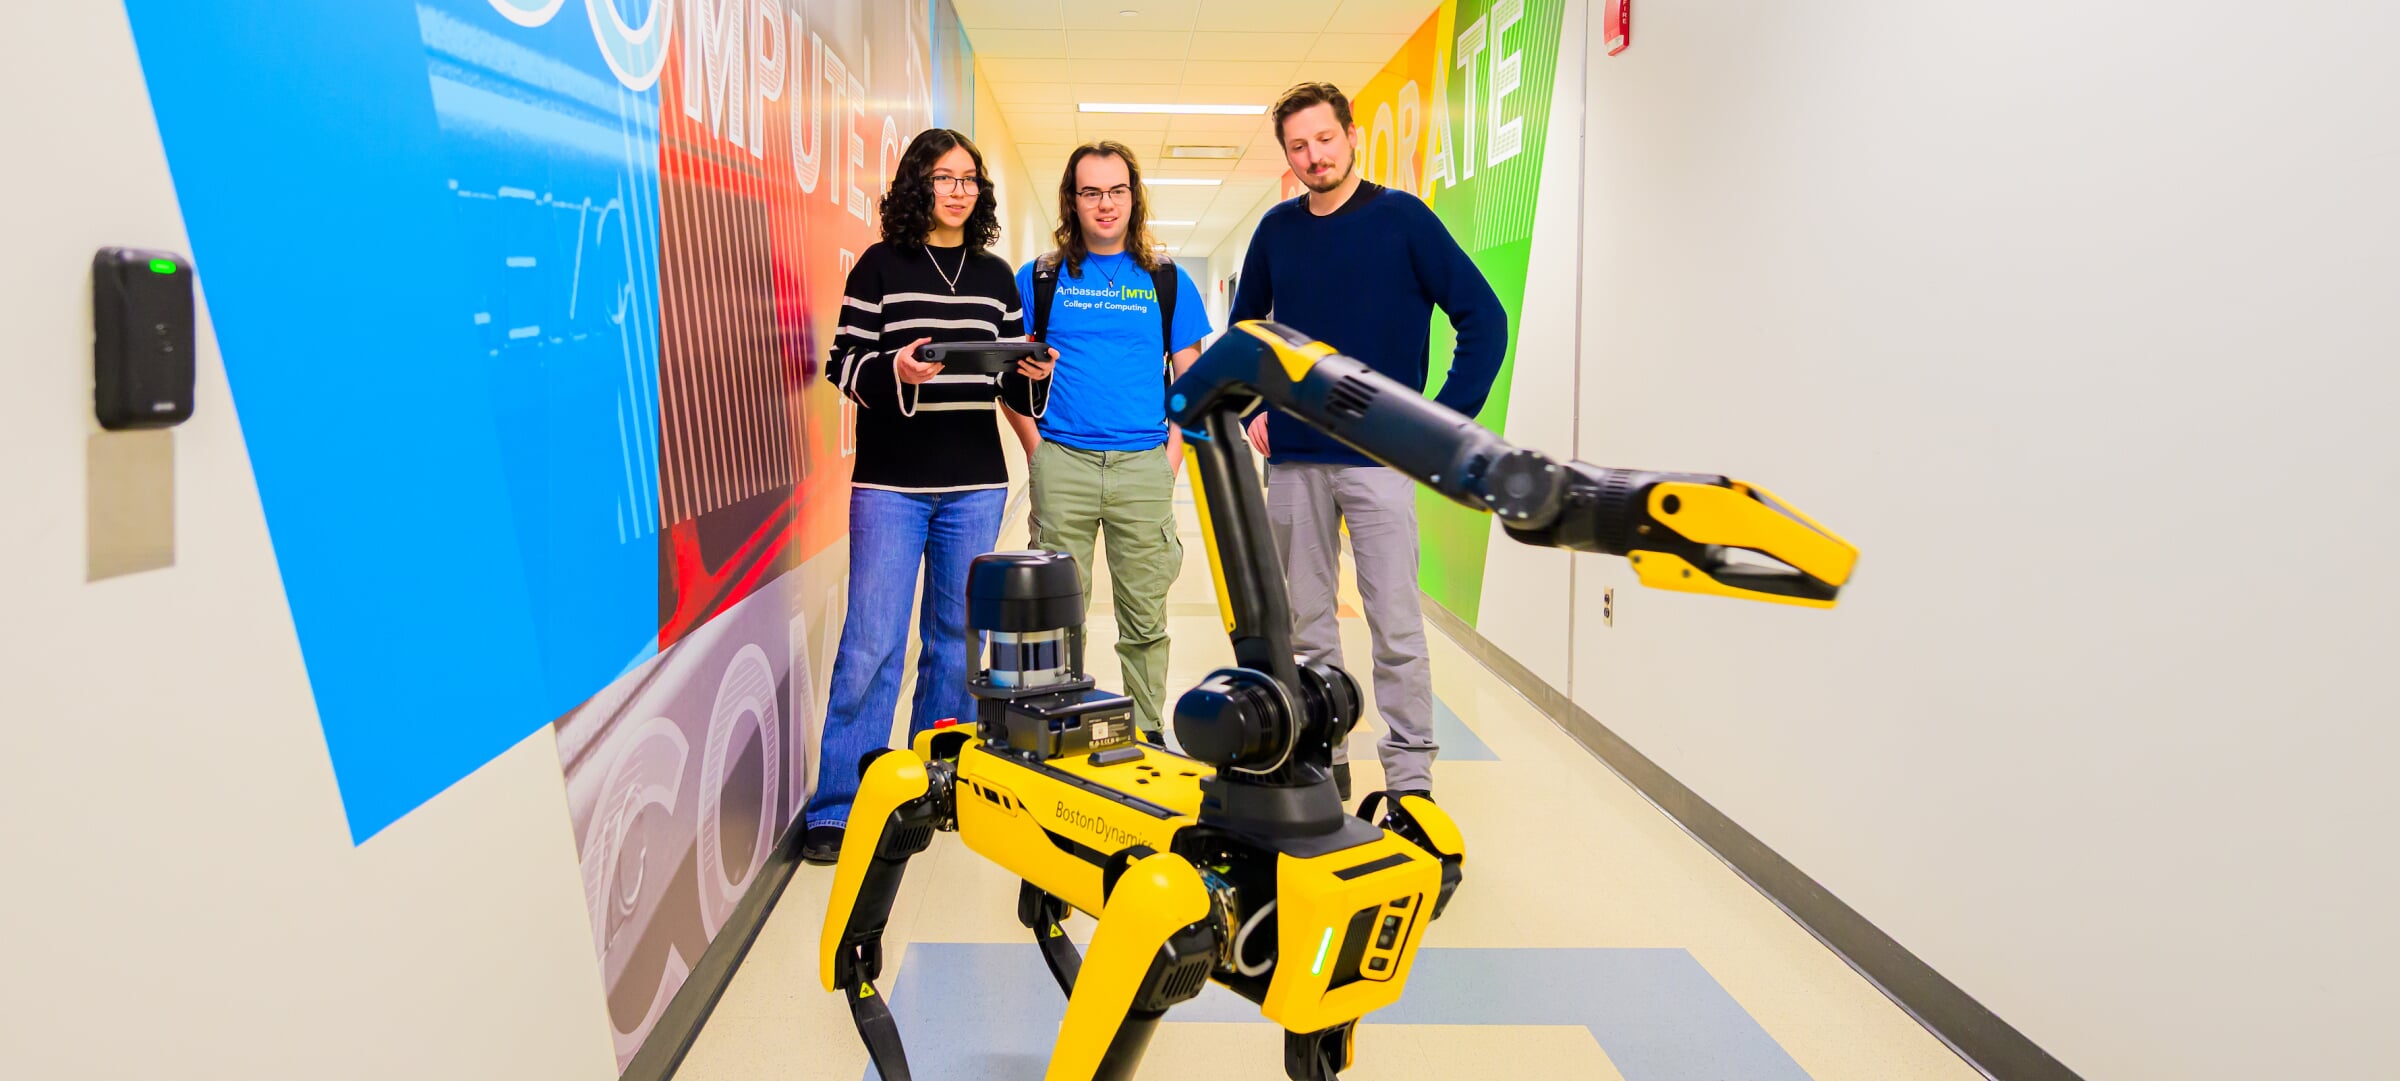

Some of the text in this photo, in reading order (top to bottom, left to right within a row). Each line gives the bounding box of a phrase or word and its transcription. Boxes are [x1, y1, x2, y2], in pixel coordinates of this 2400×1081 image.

[1056, 286, 1120, 297] Ambassador
[1063, 300, 1147, 313] College of Computing
